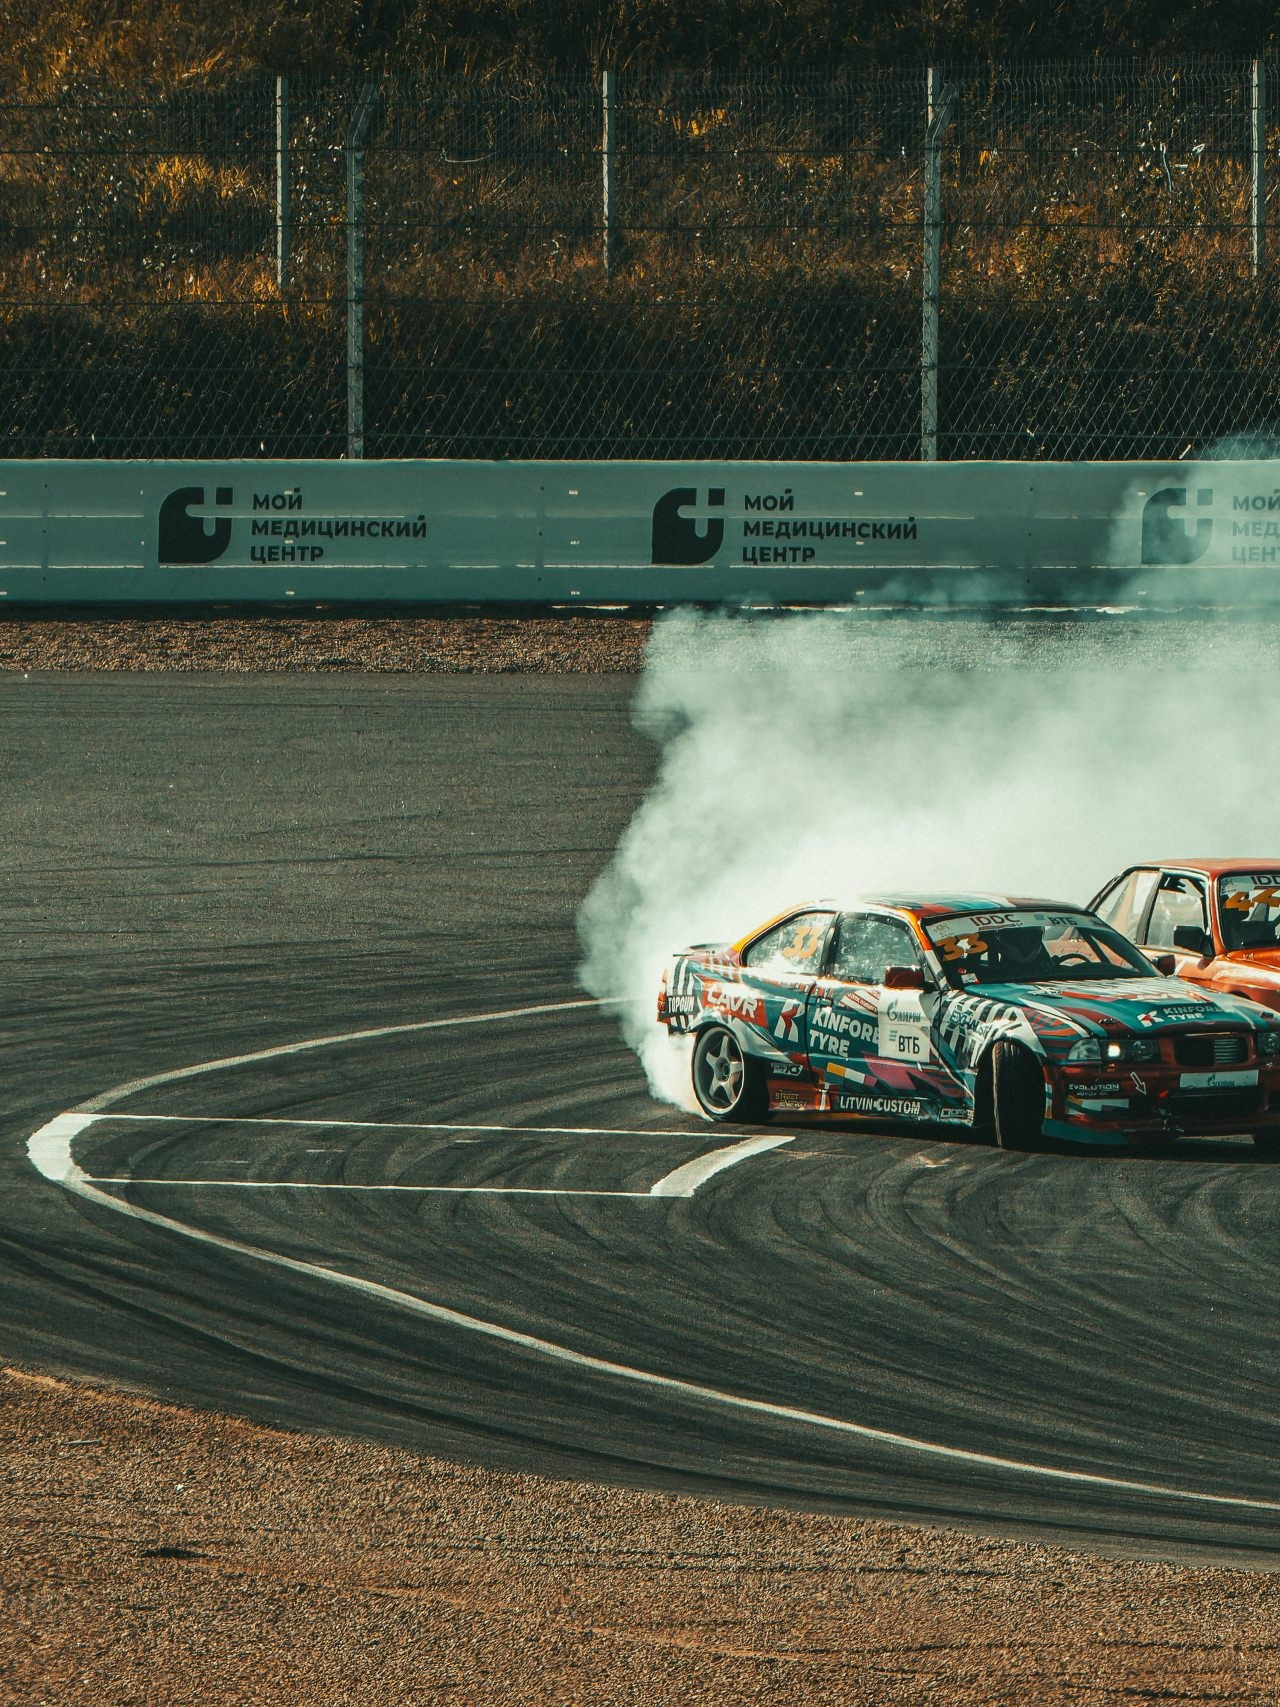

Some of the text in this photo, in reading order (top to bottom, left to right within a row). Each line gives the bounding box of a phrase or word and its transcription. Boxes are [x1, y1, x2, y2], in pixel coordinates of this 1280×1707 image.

[252, 487, 303, 511] МОЙ
[744, 488, 794, 511] МОЙ
[251, 515, 427, 538] МЕДИЦИНСКИЙ
[743, 516, 918, 540] МЕДИЦИНСКИЙ
[250, 545, 324, 564] ЦЕНТР
[742, 546, 815, 565] ЦЕНТР
[970, 914, 1021, 927] IDDC
[782, 926, 826, 959] 33
[935, 932, 988, 960] 33
[809, 1029, 850, 1059] TYRE
[898, 1034, 920, 1055] ВТБ
